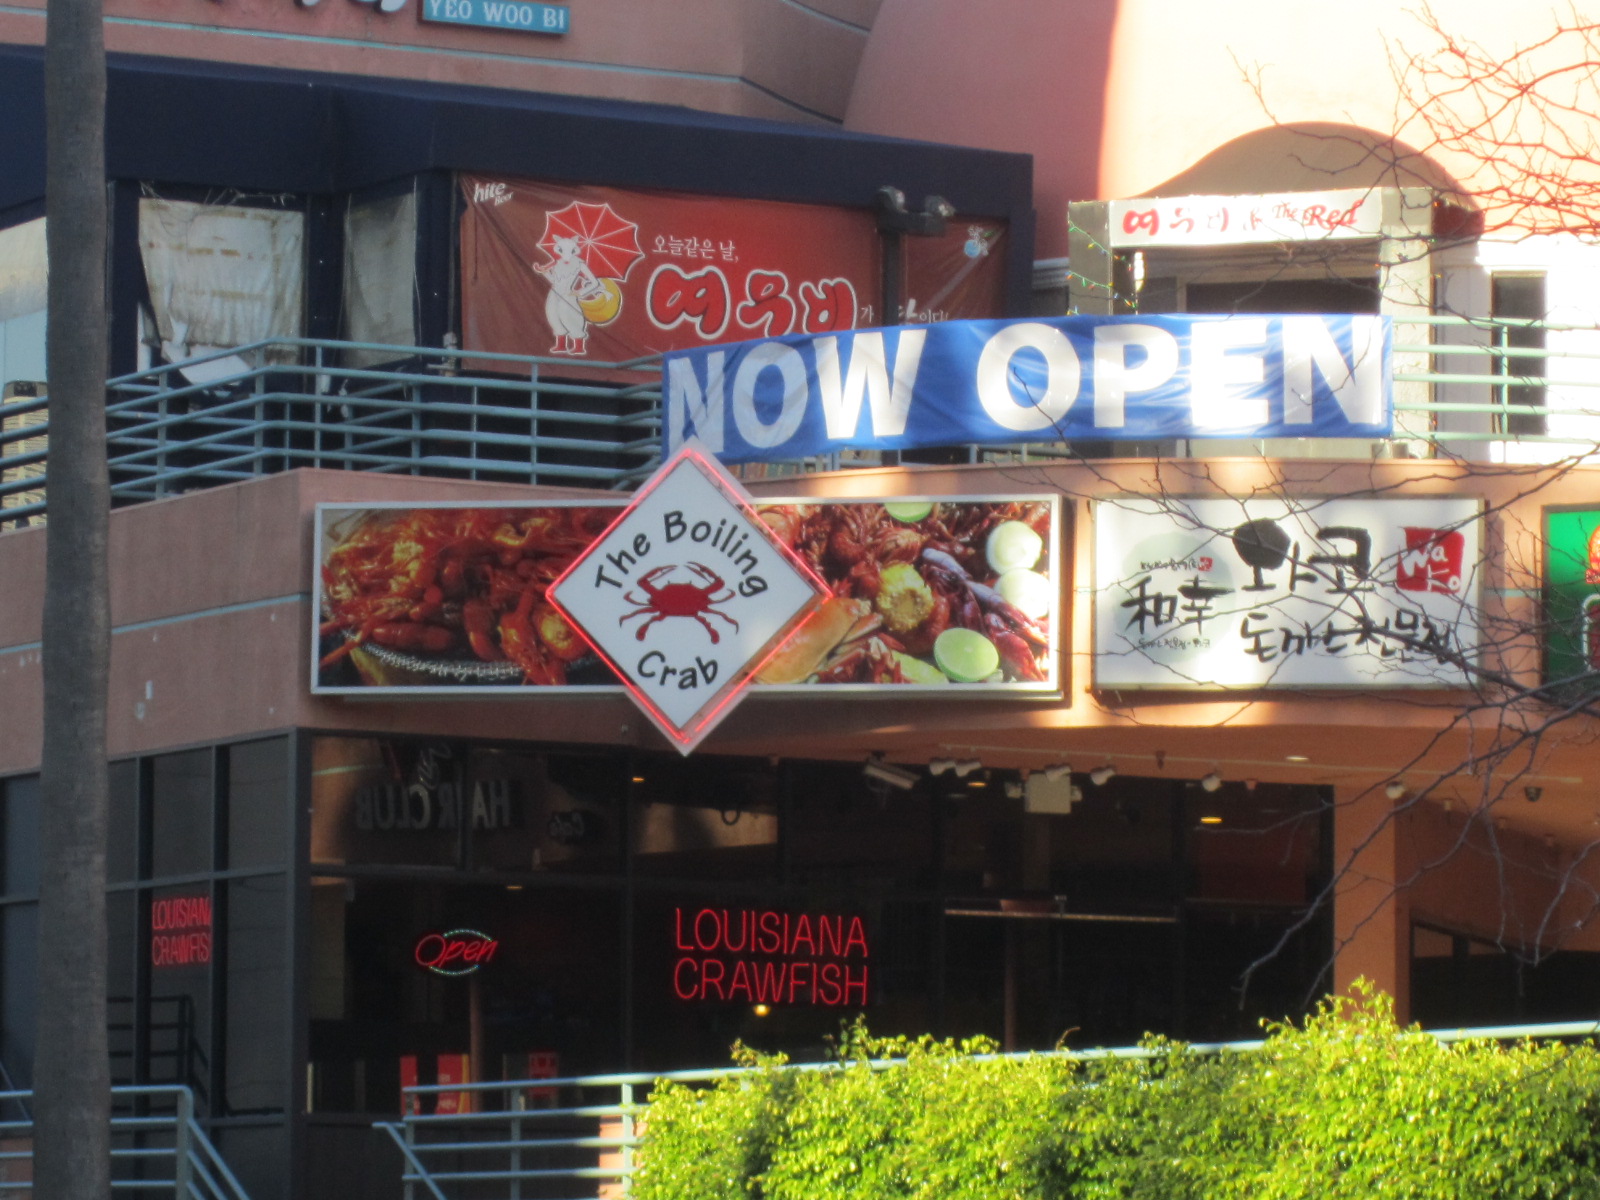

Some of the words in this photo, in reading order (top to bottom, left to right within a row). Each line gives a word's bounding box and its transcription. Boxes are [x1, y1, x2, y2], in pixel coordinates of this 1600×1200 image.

[431, 0, 472, 18] YEO
[484, 2, 532, 25] WOO
[543, 8, 564, 29] BI
[474, 183, 505, 203] hite
[1303, 199, 1364, 230] Red
[667, 328, 927, 456] NOW
[976, 314, 1384, 432] OPEN
[595, 533, 651, 588] The
[663, 510, 768, 598] Boiling
[637, 650, 718, 690] Crab
[152, 932, 212, 966] CRAWFIS
[415, 933, 498, 968] Open
[675, 908, 868, 957] LOUISIANA
[673, 957, 868, 1006] CRAWFISH
